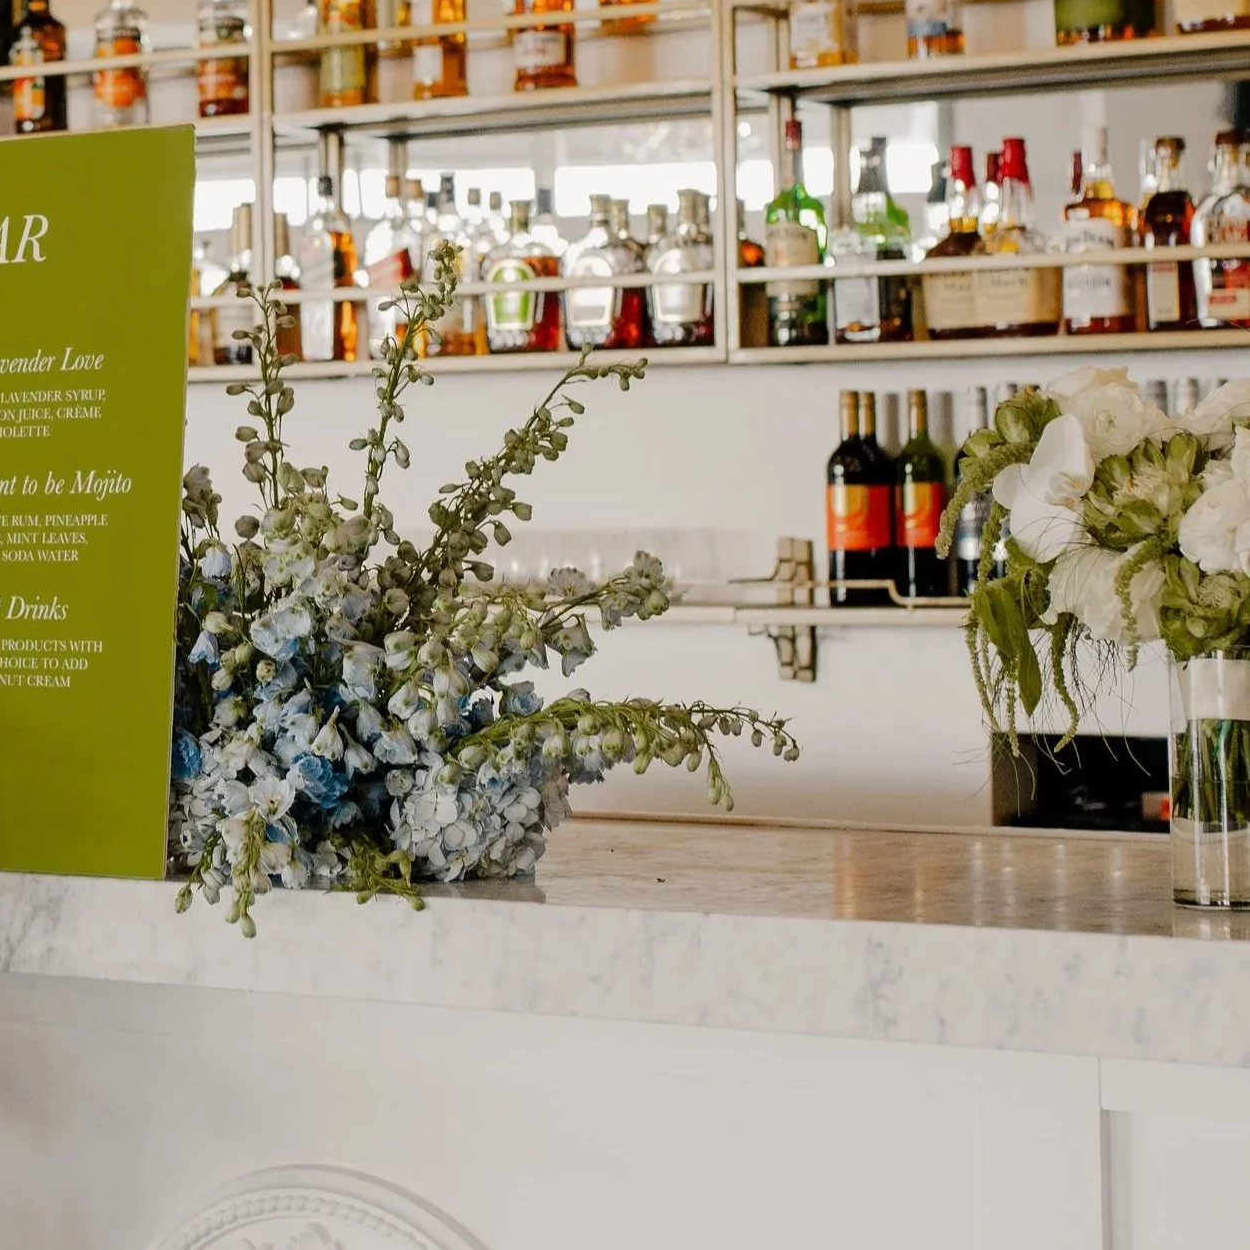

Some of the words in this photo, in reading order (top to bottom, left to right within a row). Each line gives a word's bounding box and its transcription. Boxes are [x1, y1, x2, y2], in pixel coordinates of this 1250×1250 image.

[60, 346, 104, 371] Love
[0, 390, 62, 404] LAVENDER
[65, 388, 106, 402] SYRUP,
[16, 407, 54, 423] JUICE,
[56, 405, 102, 419] CRÈME
[22, 475, 38, 495] to
[44, 470, 65, 494] be
[69, 469, 132, 501] Mojito
[11, 514, 42, 528] RUM,
[45, 513, 109, 527] PINEAPPLE
[6, 532, 40, 545] MINT
[42, 532, 88, 546] LEAVES,
[1, 550, 34, 562] SODA
[37, 550, 79, 562] WATER
[6, 595, 69, 621] Drinks
[1, 639, 67, 652] PRODUCTS
[69, 640, 103, 653] WITH
[41, 657, 59, 670] TO
[61, 658, 88, 671] ADD
[27, 674, 71, 688] CREAM
